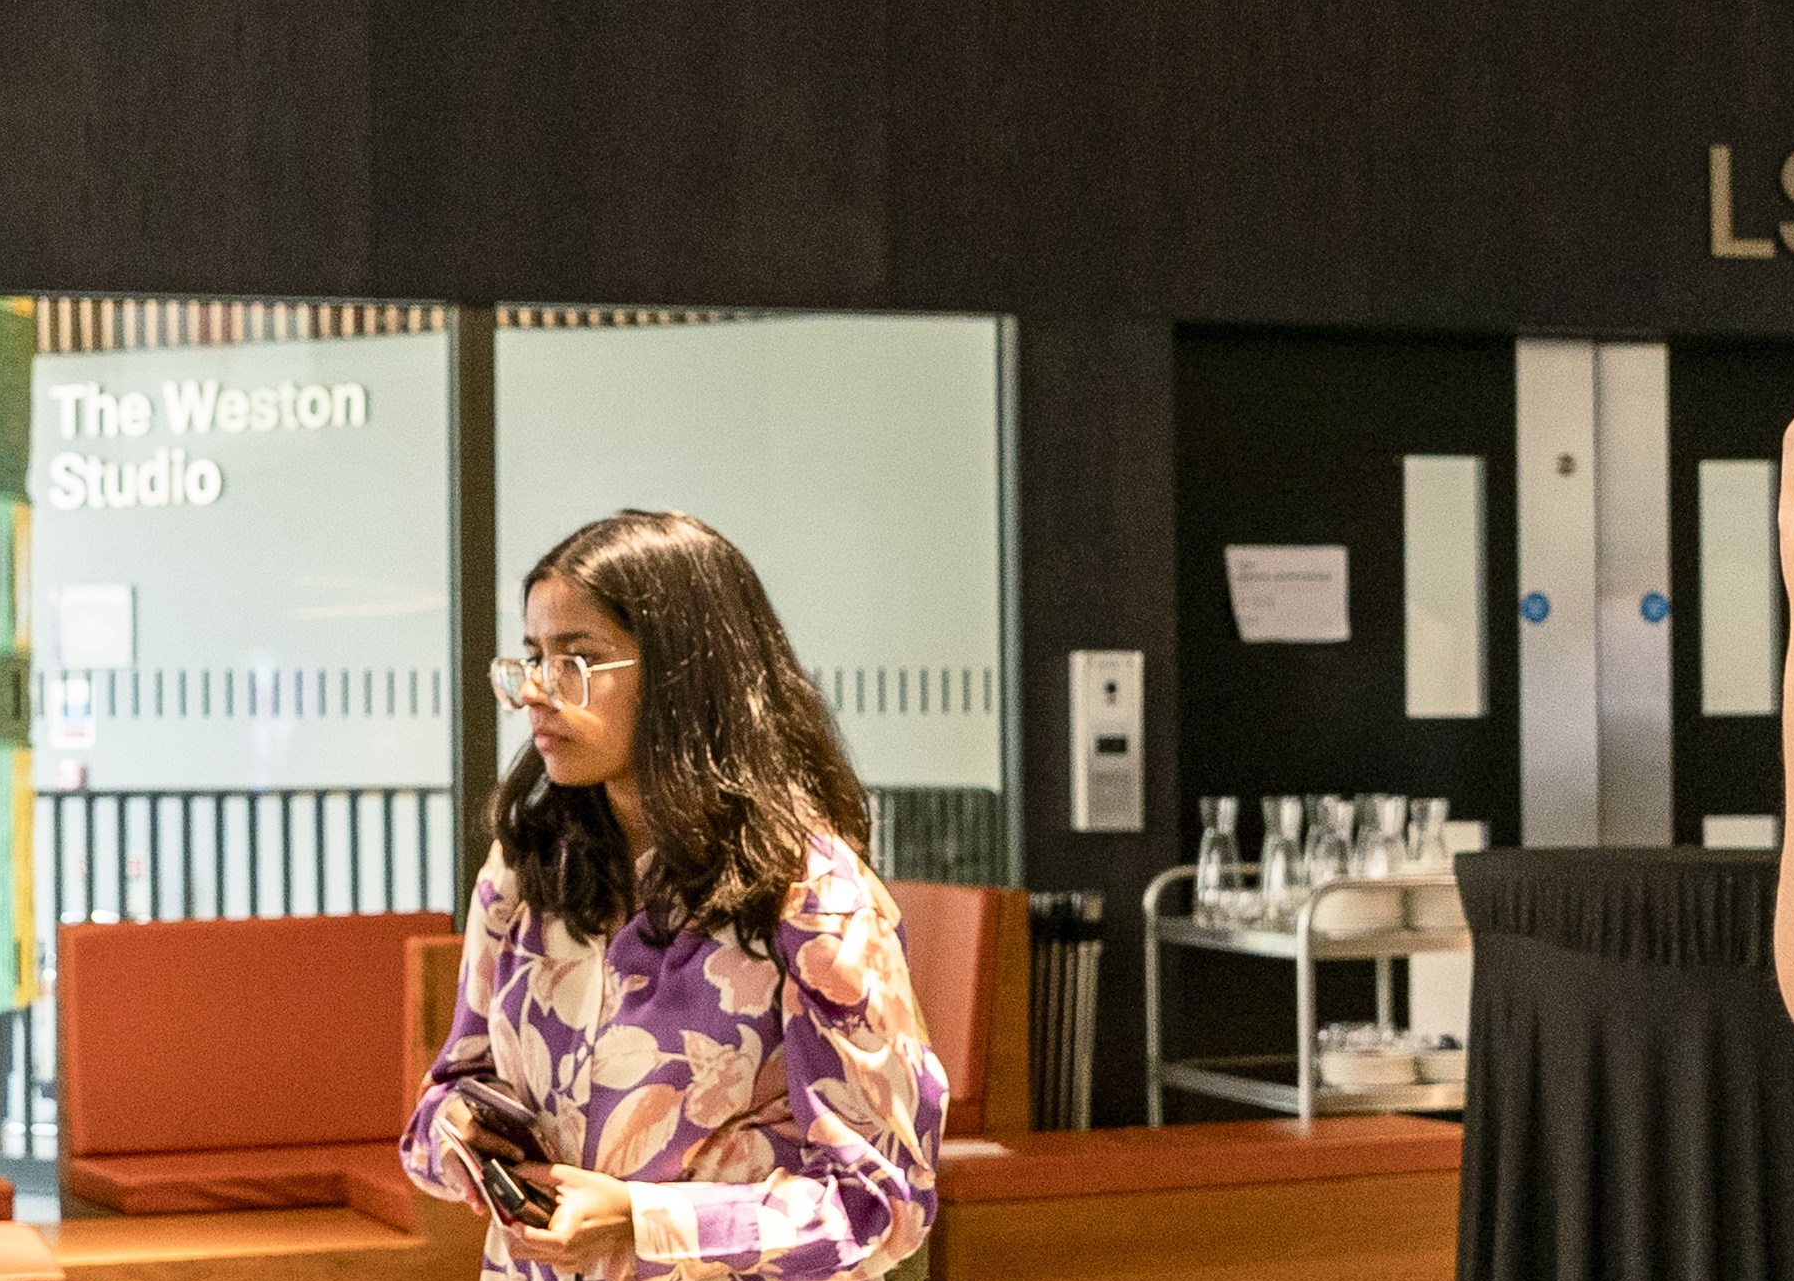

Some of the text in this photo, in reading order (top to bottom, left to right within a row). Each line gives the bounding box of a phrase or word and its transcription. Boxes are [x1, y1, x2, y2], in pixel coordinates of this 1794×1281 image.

[48, 375, 369, 440] The Weston
[46, 448, 224, 511] Studio
